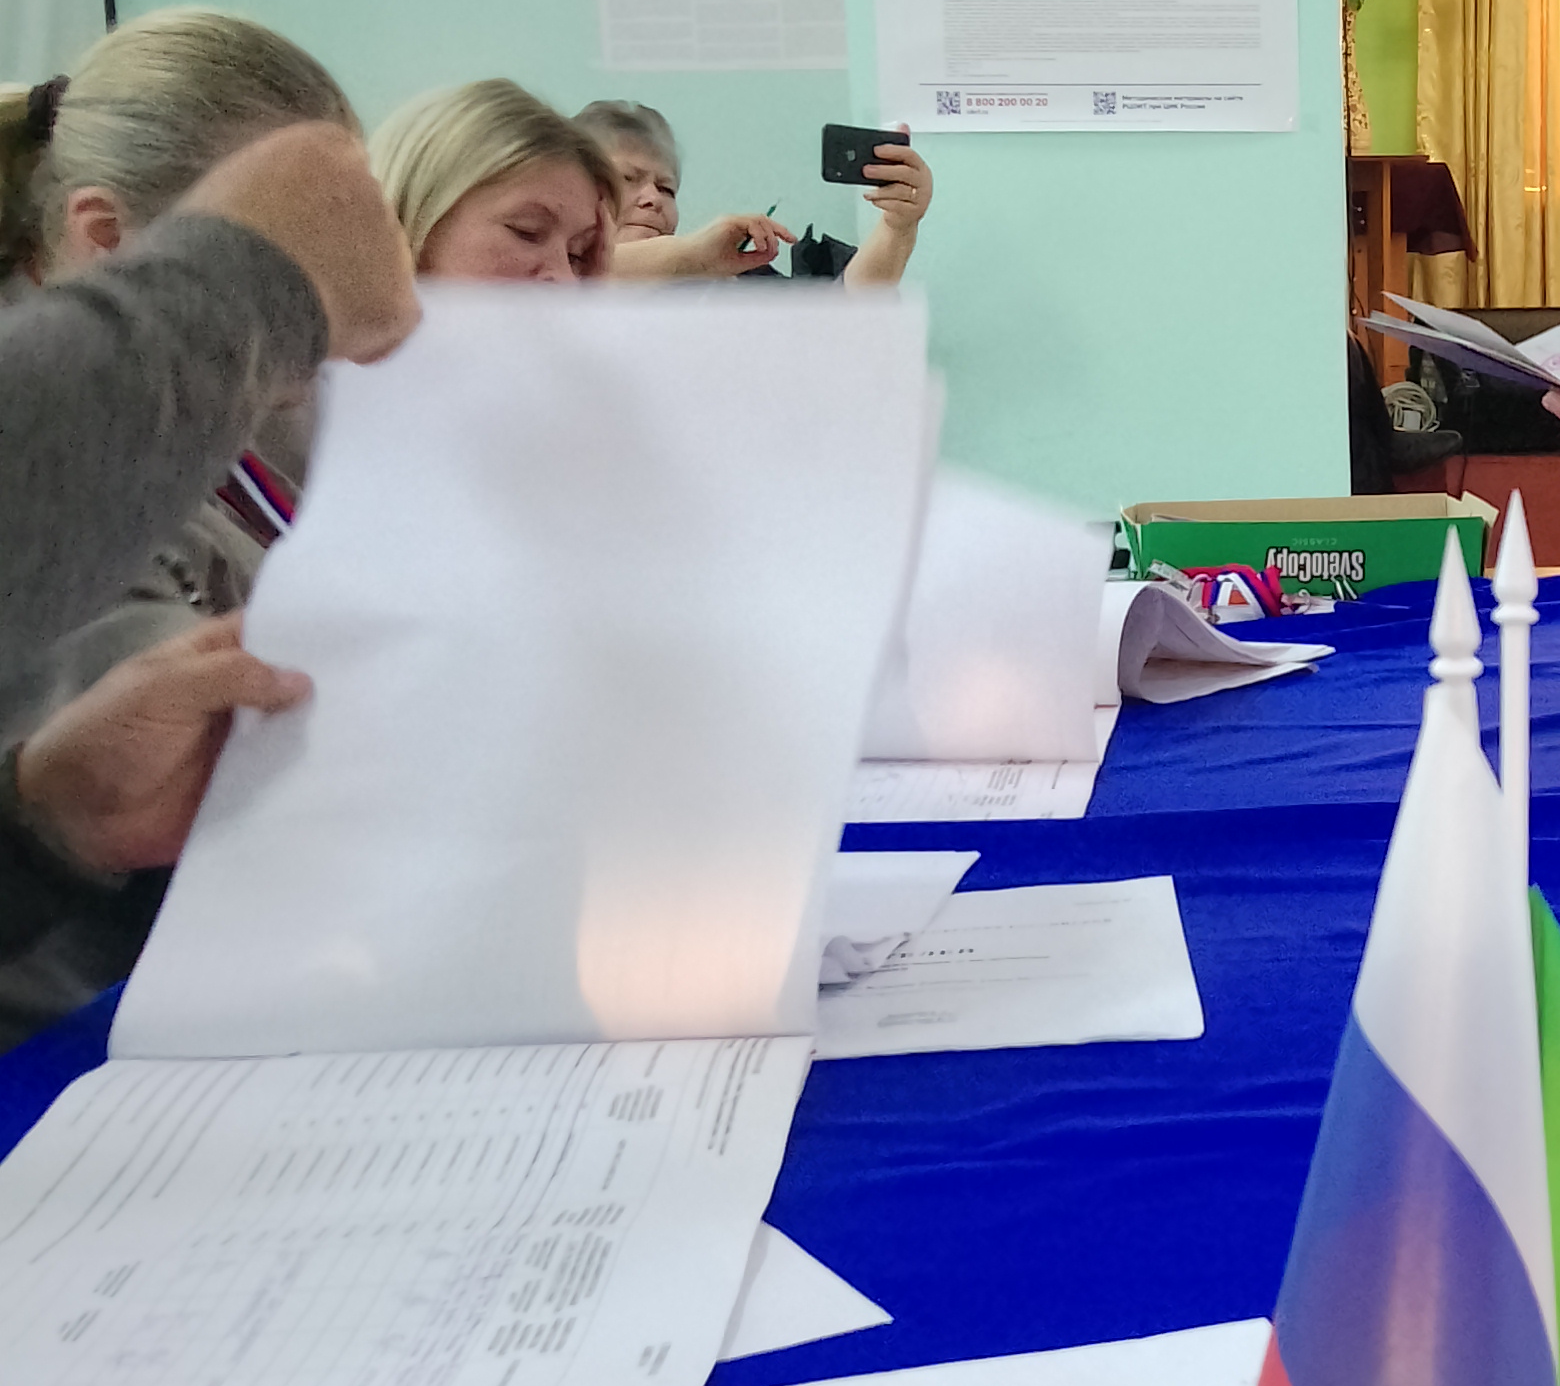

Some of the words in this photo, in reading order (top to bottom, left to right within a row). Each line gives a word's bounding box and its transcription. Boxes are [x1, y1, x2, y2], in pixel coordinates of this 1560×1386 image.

[966, 98, 973, 107] 8
[975, 98, 995, 107] 800
[998, 98, 1018, 107] 200
[1020, 98, 1033, 107] 00
[1035, 98, 1048, 107] 20
[1266, 547, 1364, 582] SvetoCopy
